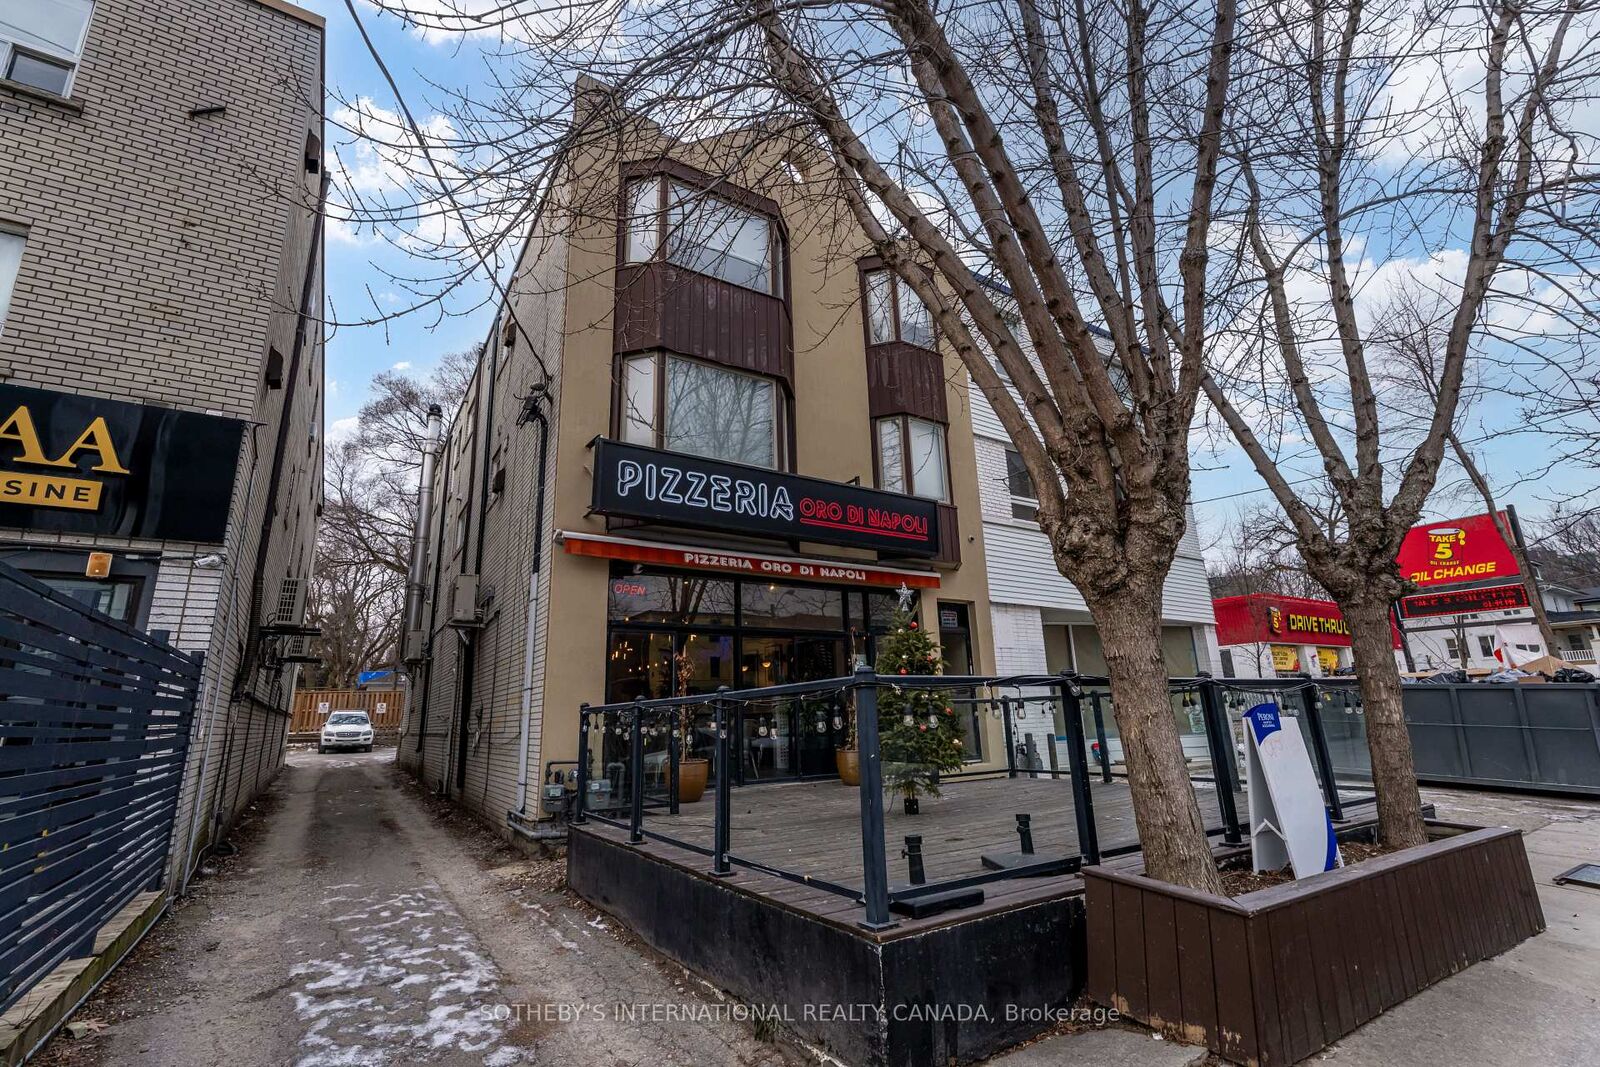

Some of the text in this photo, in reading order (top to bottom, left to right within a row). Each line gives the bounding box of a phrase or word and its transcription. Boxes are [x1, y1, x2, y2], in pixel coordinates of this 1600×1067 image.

[617, 459, 794, 521] PIZZERIA
[800, 497, 928, 535] ORO DI NAPOLI
[1428, 534, 1456, 543] TAKE
[1434, 542, 1453, 559] 5
[684, 552, 866, 581] PIZZERIA ORO DI NAPOLI
[1410, 561, 1496, 583] OIL CHANGE
[614, 583, 646, 596] OPEN
[1289, 614, 1319, 632] DRIVE
[1319, 617, 1343, 634] THRU
